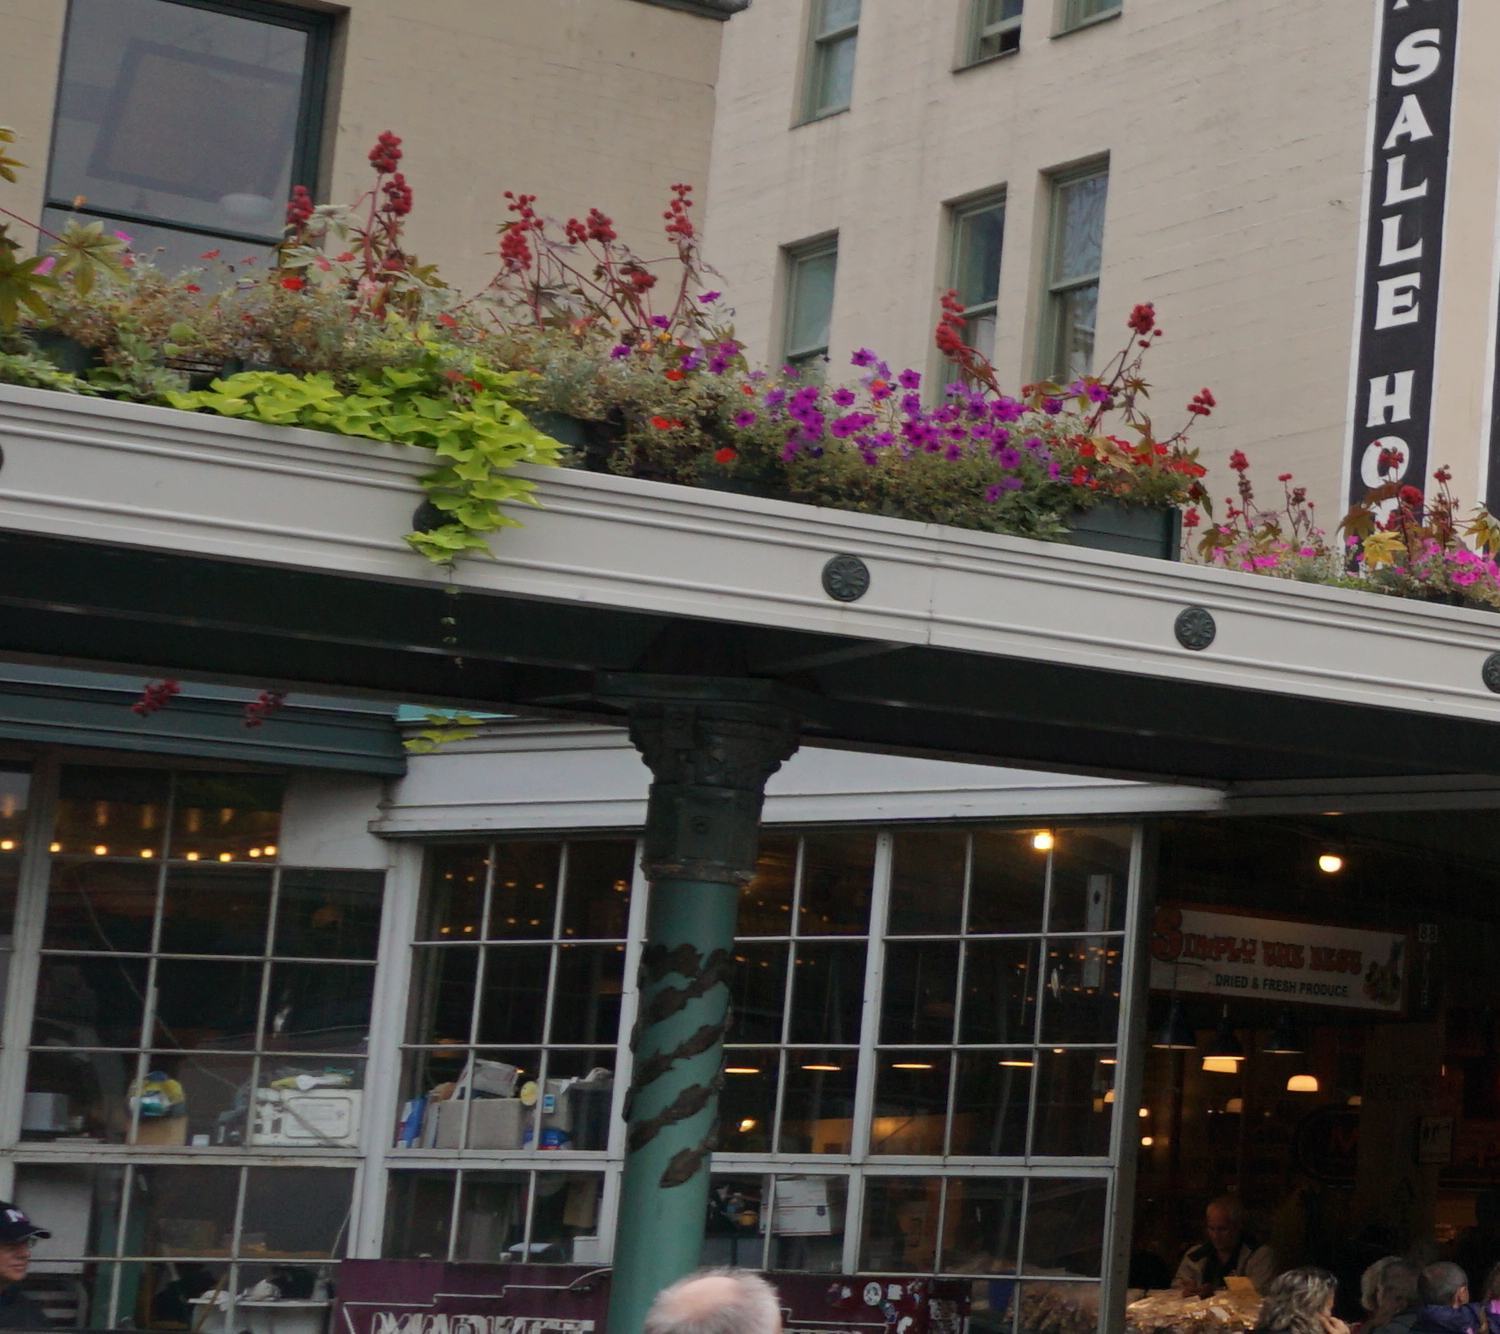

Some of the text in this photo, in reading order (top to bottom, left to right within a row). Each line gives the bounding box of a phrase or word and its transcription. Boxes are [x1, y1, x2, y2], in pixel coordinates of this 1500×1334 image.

[1374, 27, 1442, 332] SALLE
[1215, 974, 1349, 998] DRIED & FRESH PRODUCE
